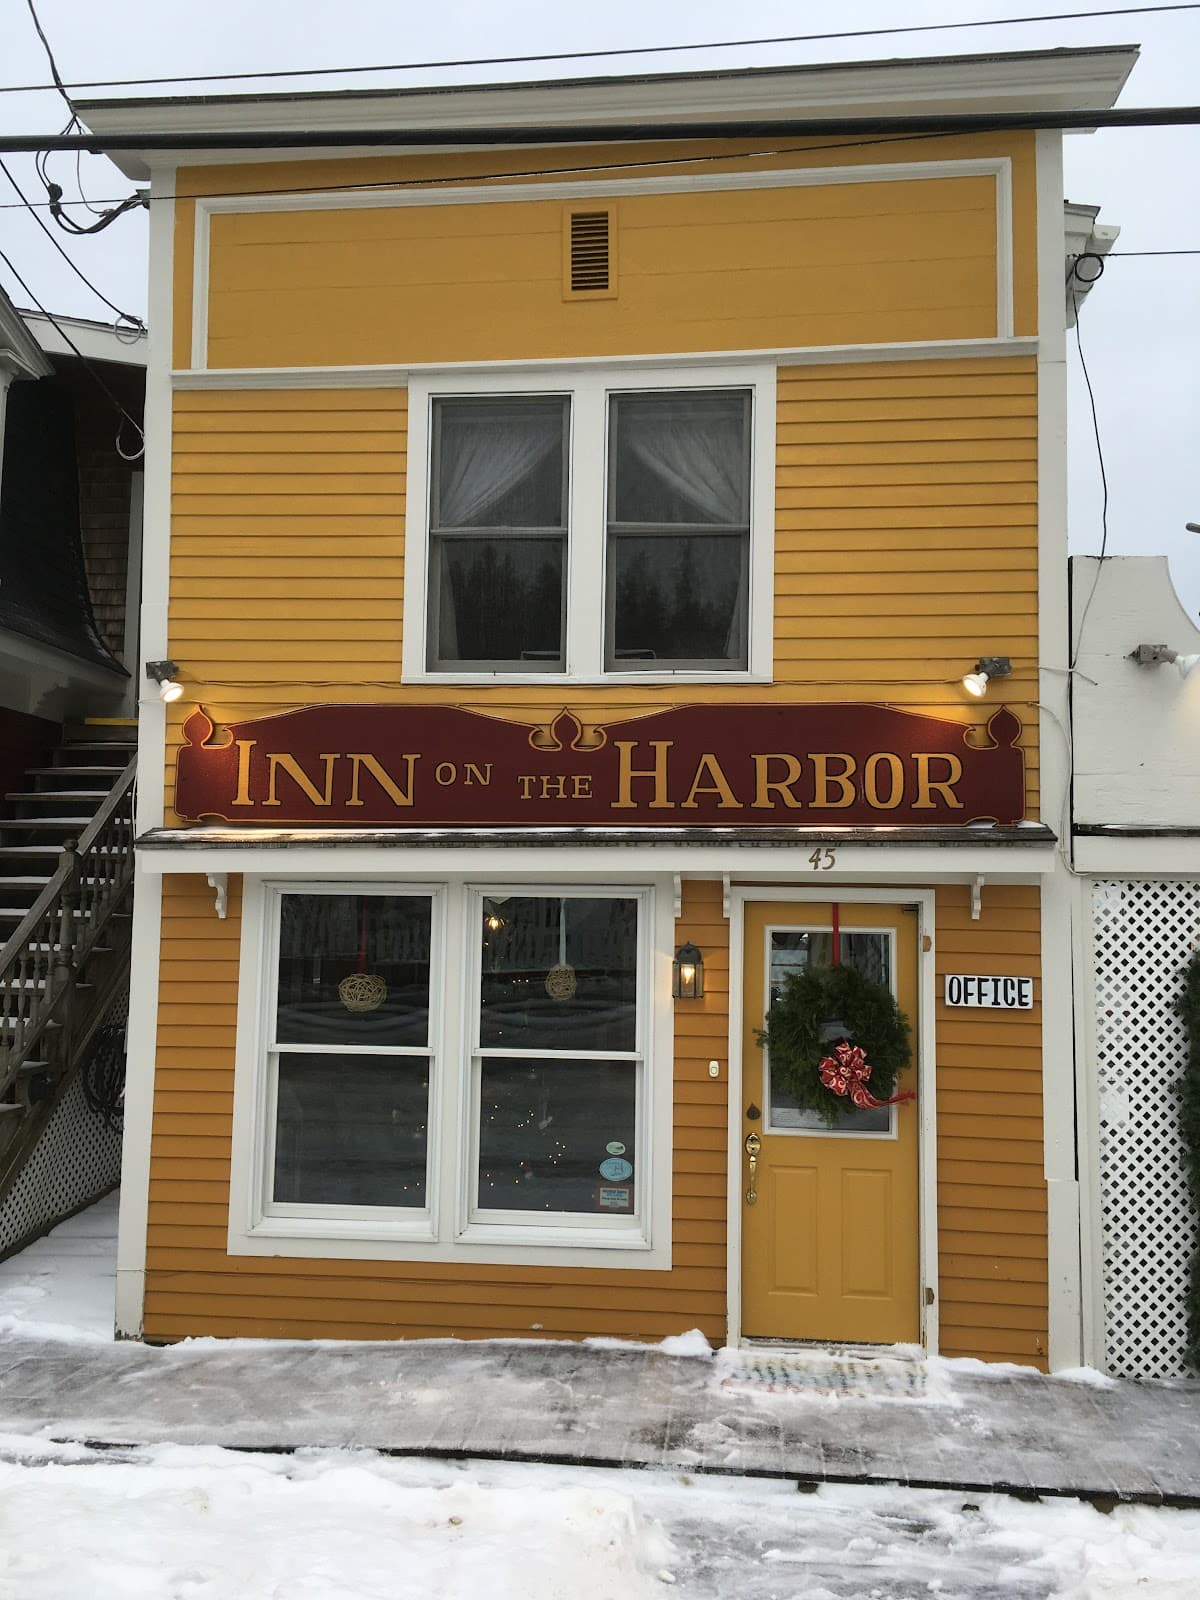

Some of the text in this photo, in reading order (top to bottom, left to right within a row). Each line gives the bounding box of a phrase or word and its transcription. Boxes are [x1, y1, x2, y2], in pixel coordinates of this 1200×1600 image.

[230, 740, 964, 809] INN ON THE HARBOR
[808, 847, 836, 870] 45
[948, 976, 1030, 1006] OFFICE
